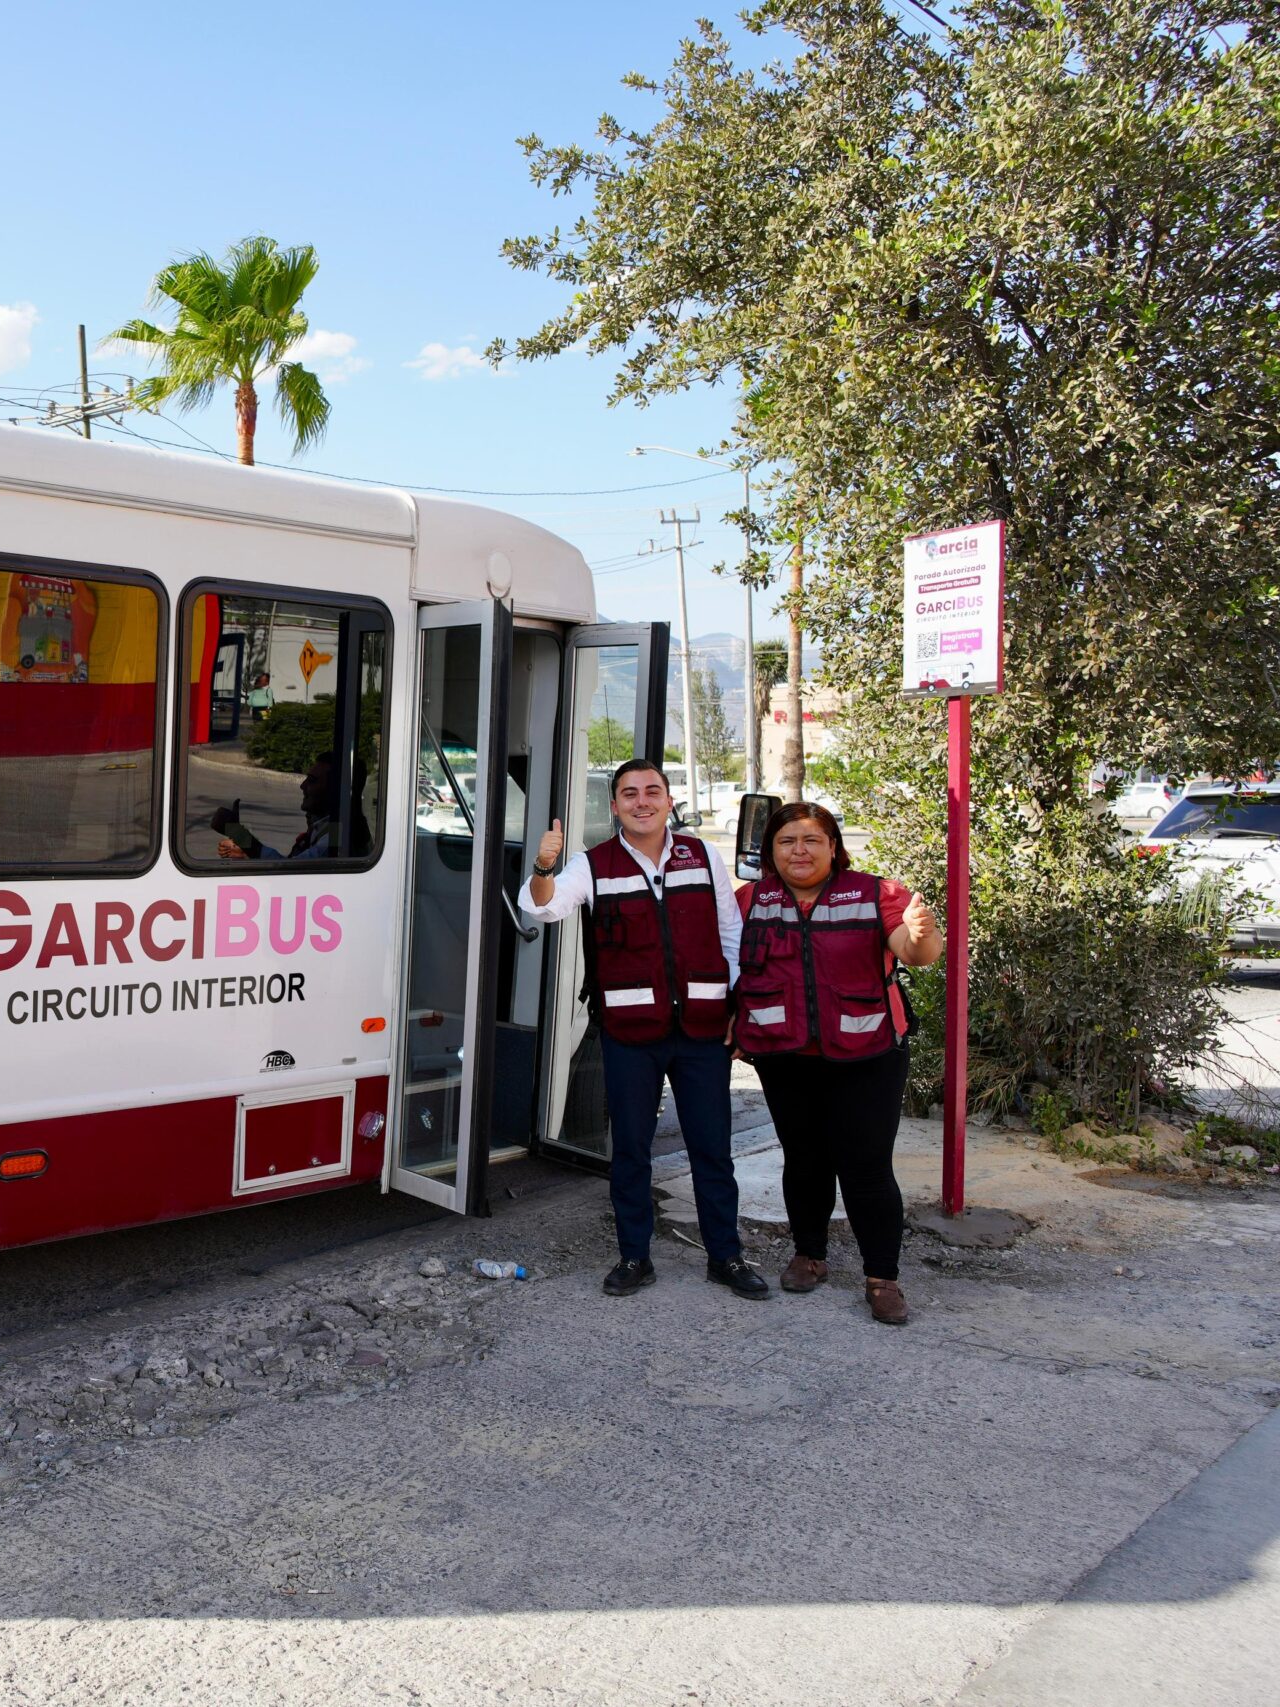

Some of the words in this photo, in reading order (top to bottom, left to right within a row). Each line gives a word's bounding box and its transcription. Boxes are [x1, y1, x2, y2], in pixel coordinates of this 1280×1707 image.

[914, 572, 941, 580] Parada
[943, 564, 986, 576] Autorizada
[920, 583, 953, 592] Transporte
[7, 981, 162, 1025] CIRCUITO
[172, 973, 306, 1011] INTERIOR
[266, 1055, 291, 1068] HBC
